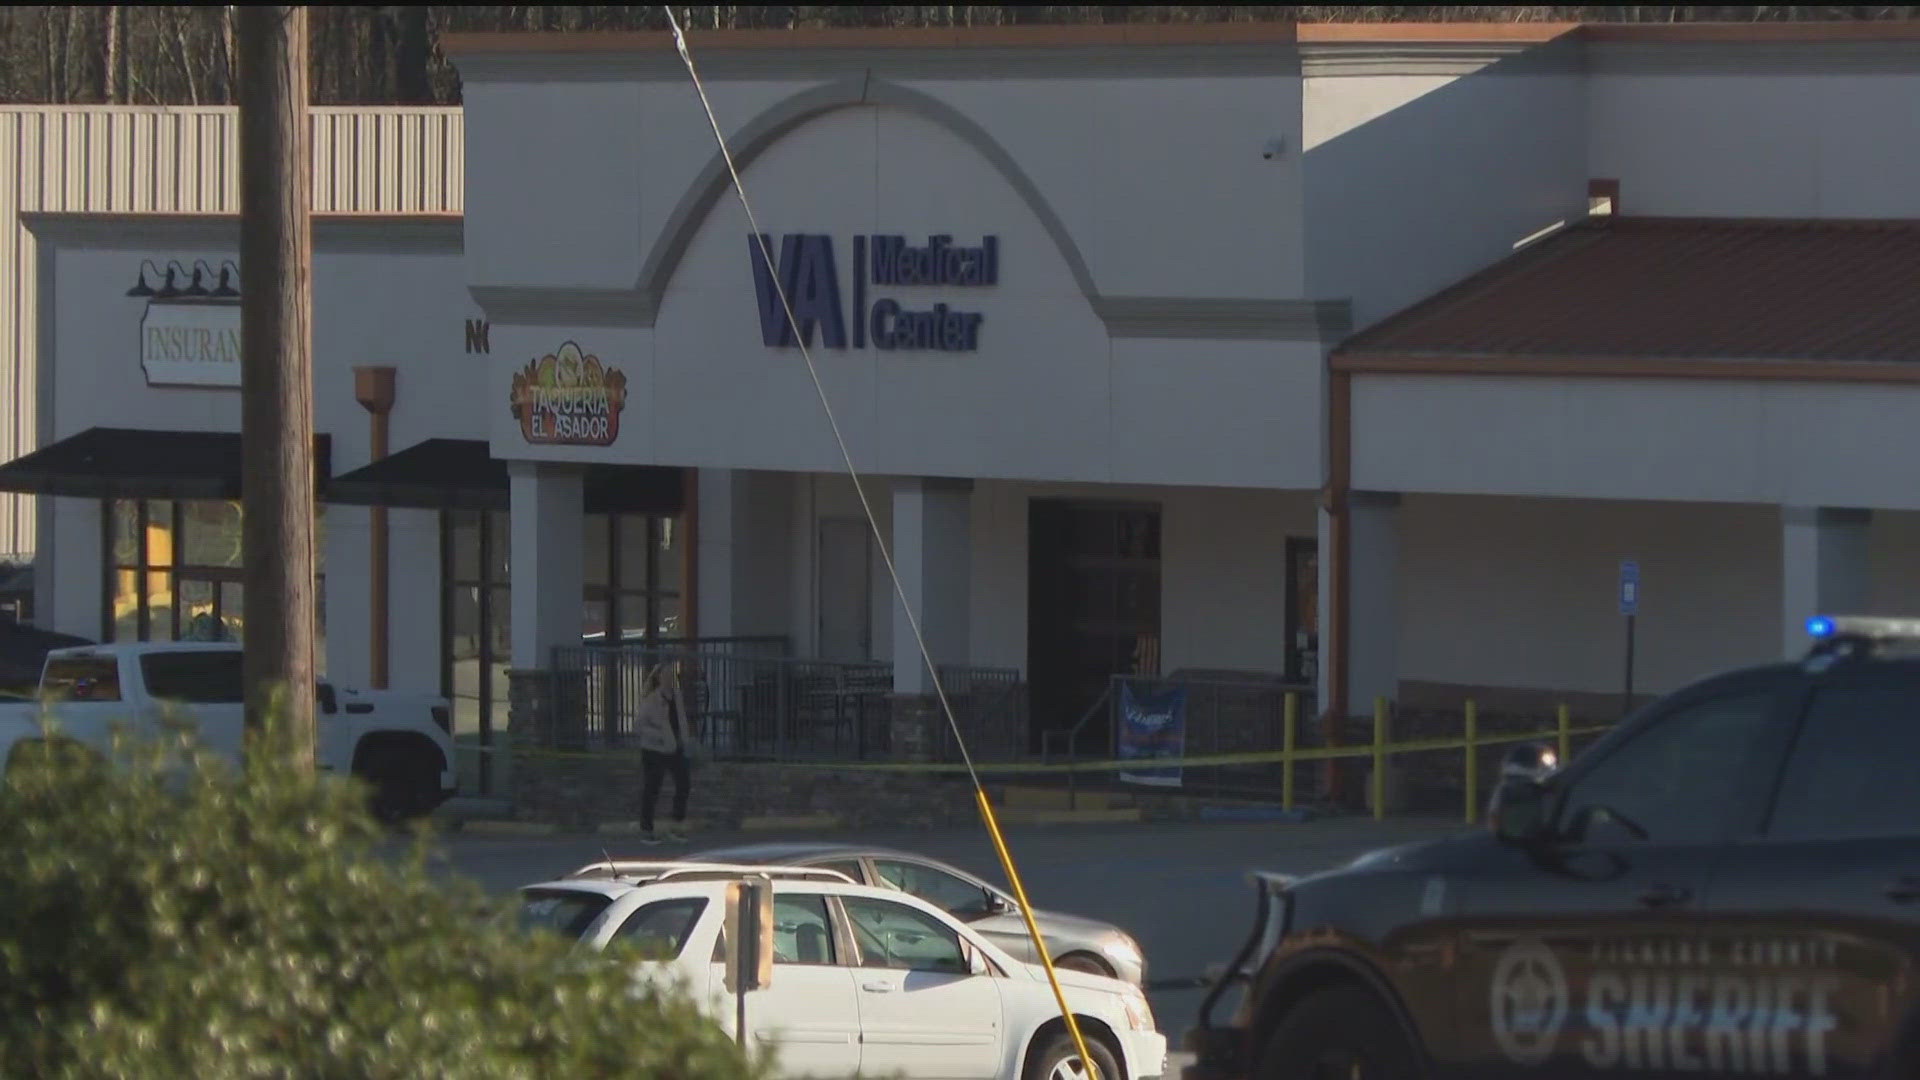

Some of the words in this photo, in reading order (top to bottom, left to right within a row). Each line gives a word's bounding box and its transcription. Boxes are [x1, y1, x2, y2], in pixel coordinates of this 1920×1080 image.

[871, 234, 999, 286] Medical
[748, 233, 848, 348] VA
[870, 298, 983, 350] Center
[530, 385, 610, 415] TAQUERIA
[531, 414, 548, 437] EL
[554, 415, 609, 439] ASADOR
[1582, 972, 1840, 1077] SHERIFF
